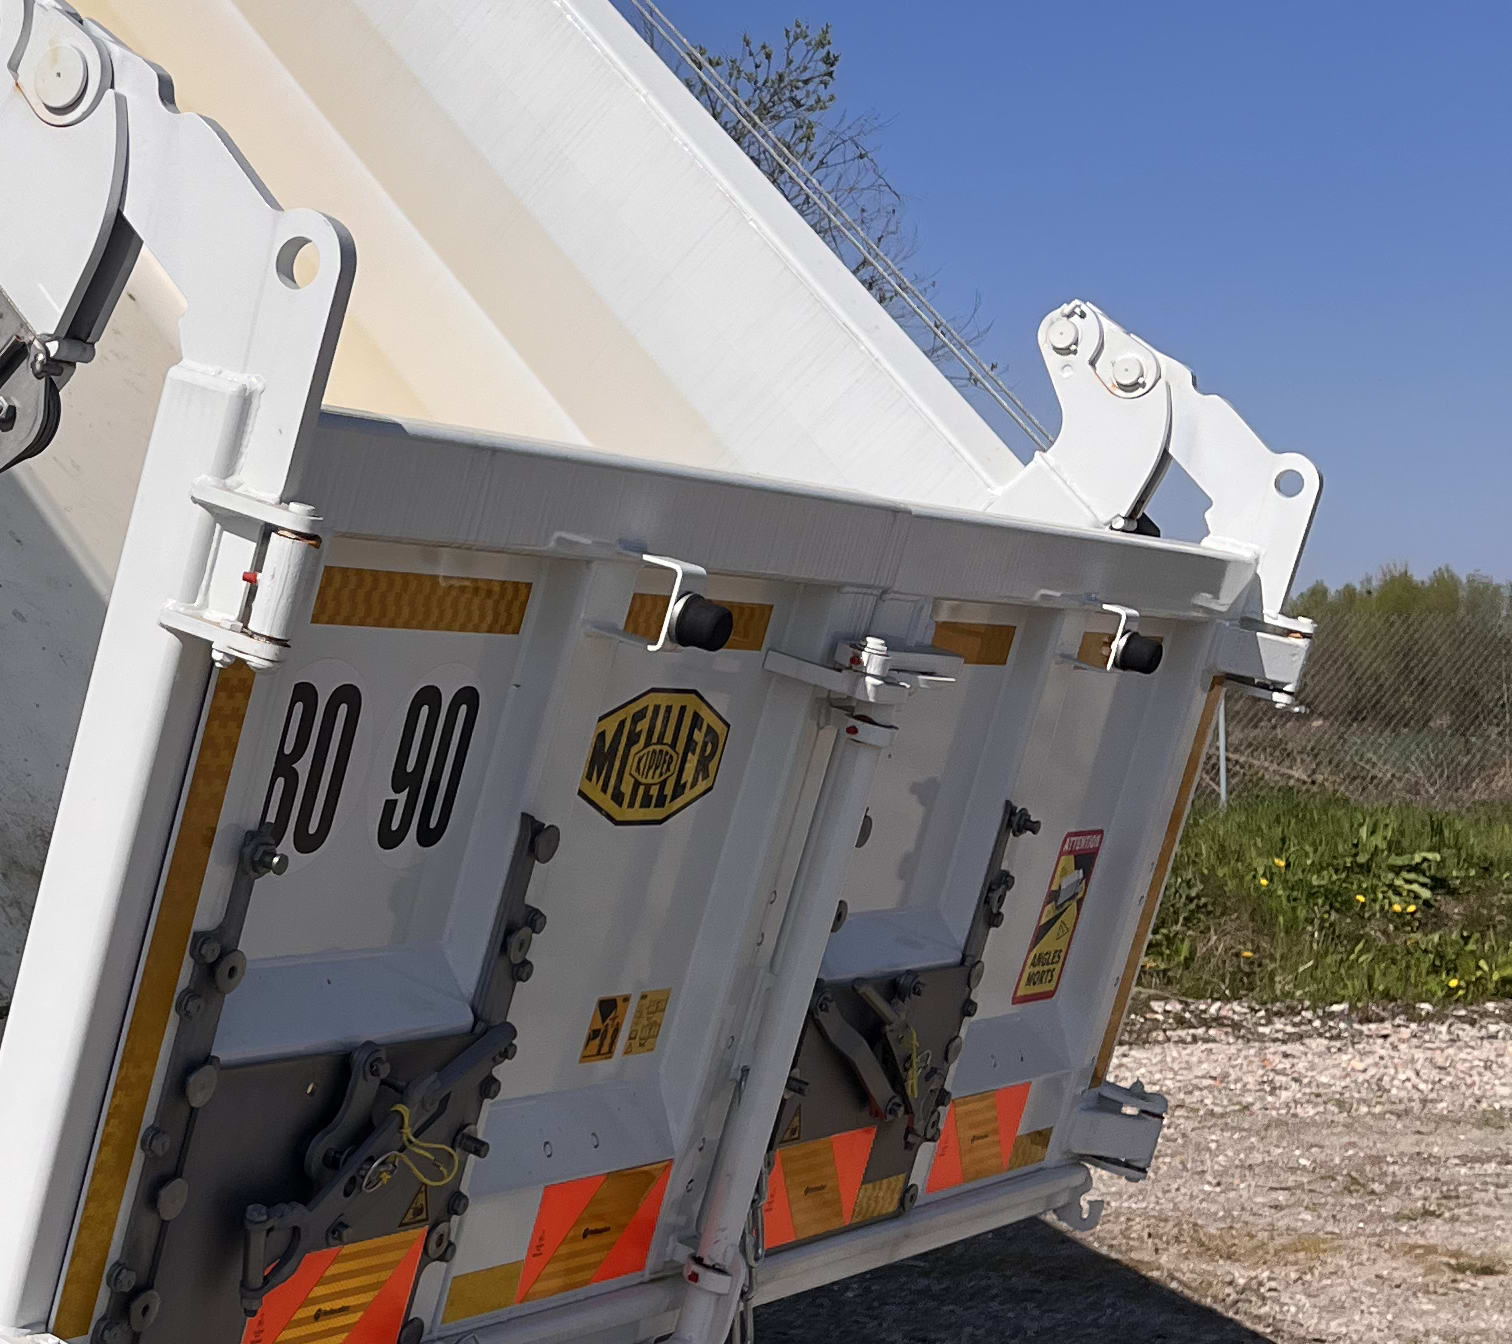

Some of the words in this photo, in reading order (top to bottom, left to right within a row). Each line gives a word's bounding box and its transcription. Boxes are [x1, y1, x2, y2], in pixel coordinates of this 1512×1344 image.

[377, 684, 480, 850] 90
[585, 703, 720, 809] MEILLER
[635, 749, 674, 780] KIPPER
[1063, 834, 1101, 852] ATTENTION
[1030, 949, 1063, 968] ANGLES
[1025, 968, 1057, 987] MORTS
